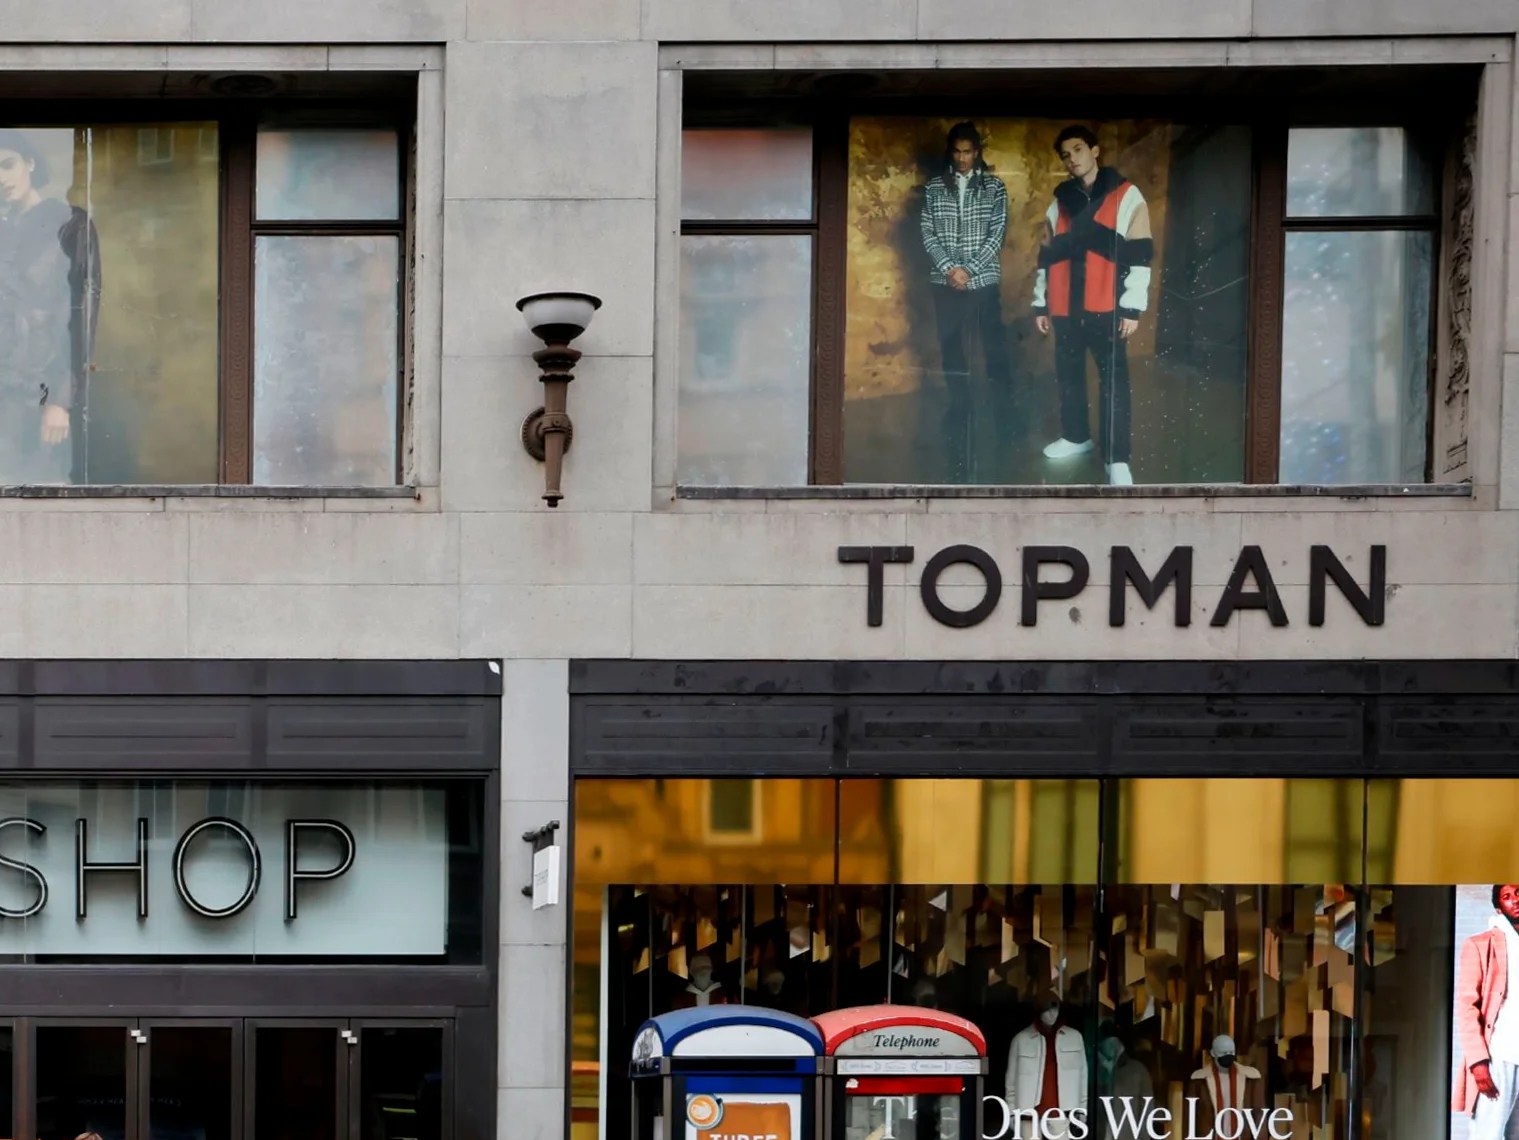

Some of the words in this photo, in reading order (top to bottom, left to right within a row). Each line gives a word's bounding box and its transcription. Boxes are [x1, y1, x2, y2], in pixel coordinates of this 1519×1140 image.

[837, 544, 1386, 628] TOPMAN
[873, 1034, 940, 1051] Telephone
[982, 1094, 1089, 1140] Ones
[1098, 1096, 1172, 1140] We
[1184, 1096, 1294, 1140] Love
